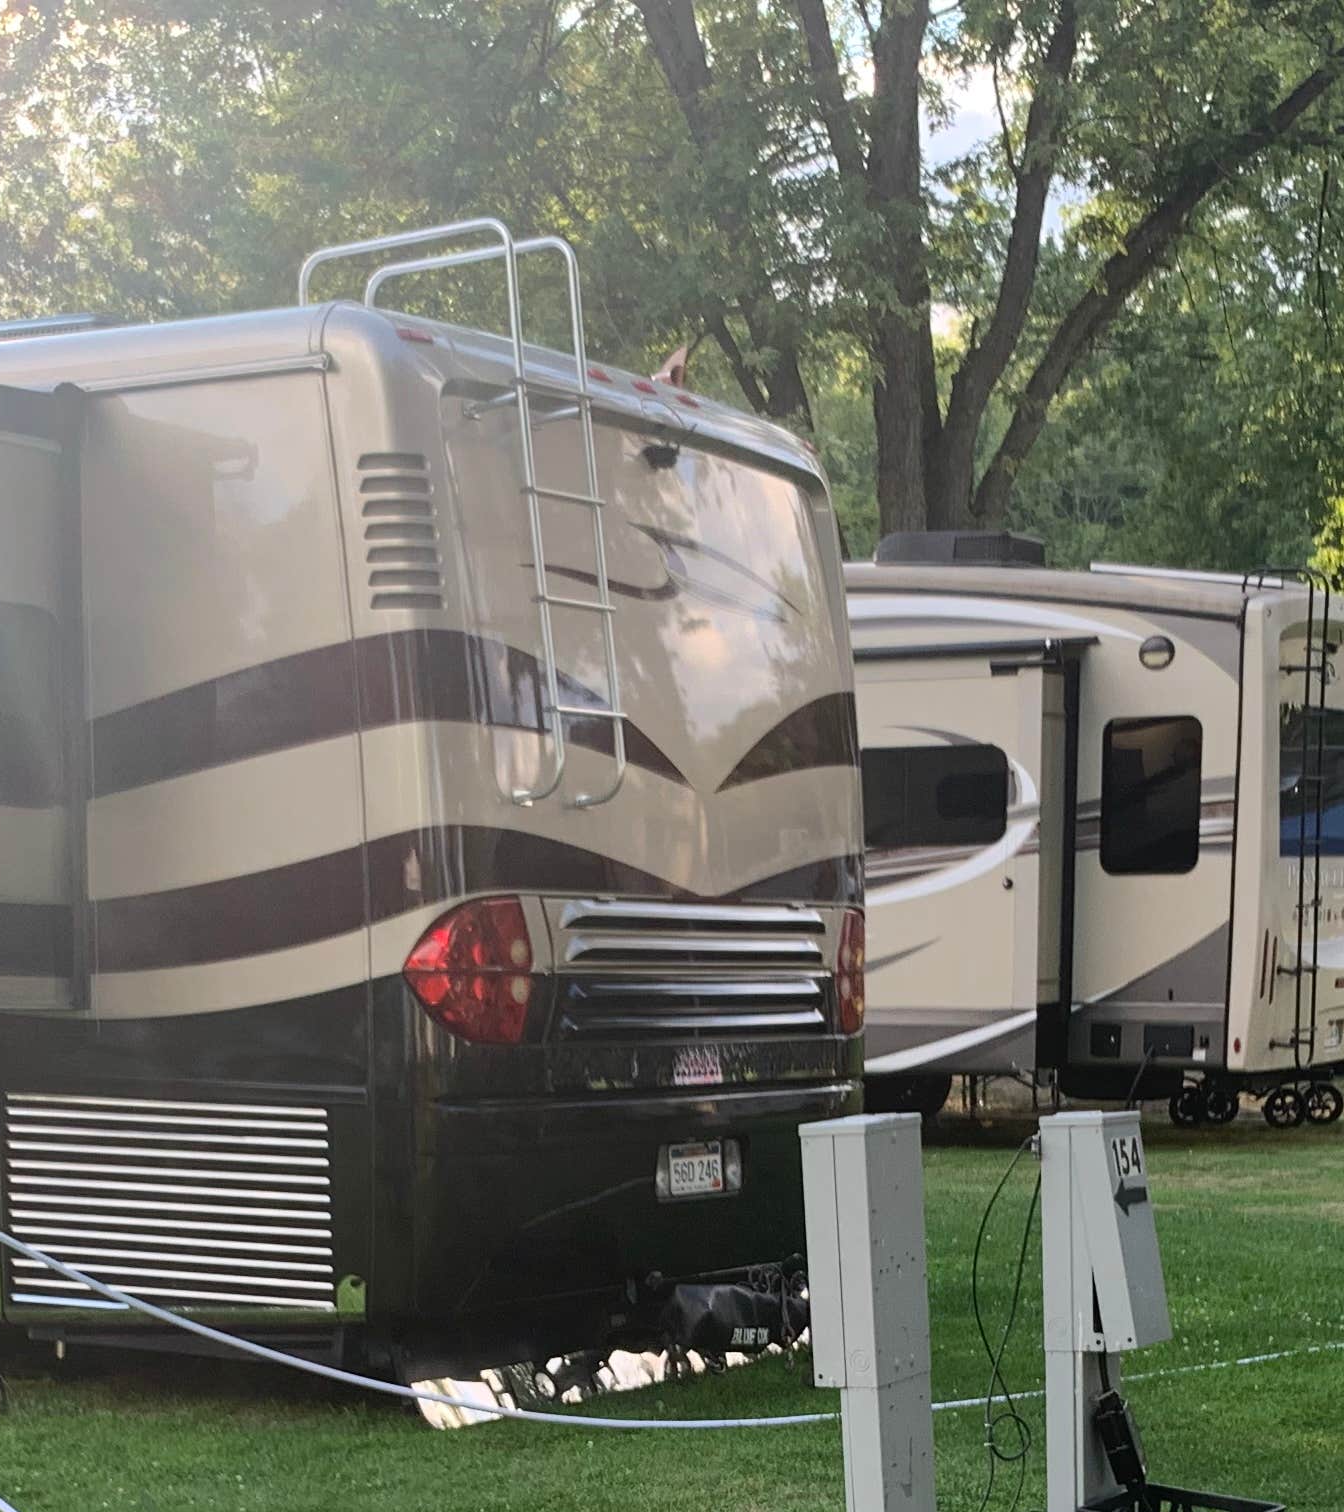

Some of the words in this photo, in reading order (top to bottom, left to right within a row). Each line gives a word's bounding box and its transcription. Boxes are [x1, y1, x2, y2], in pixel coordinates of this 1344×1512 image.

[1112, 1137, 1142, 1177] 154
[698, 1158, 720, 1184] 246
[731, 1327, 757, 1345] BLUE
[757, 1327, 769, 1345] OX
